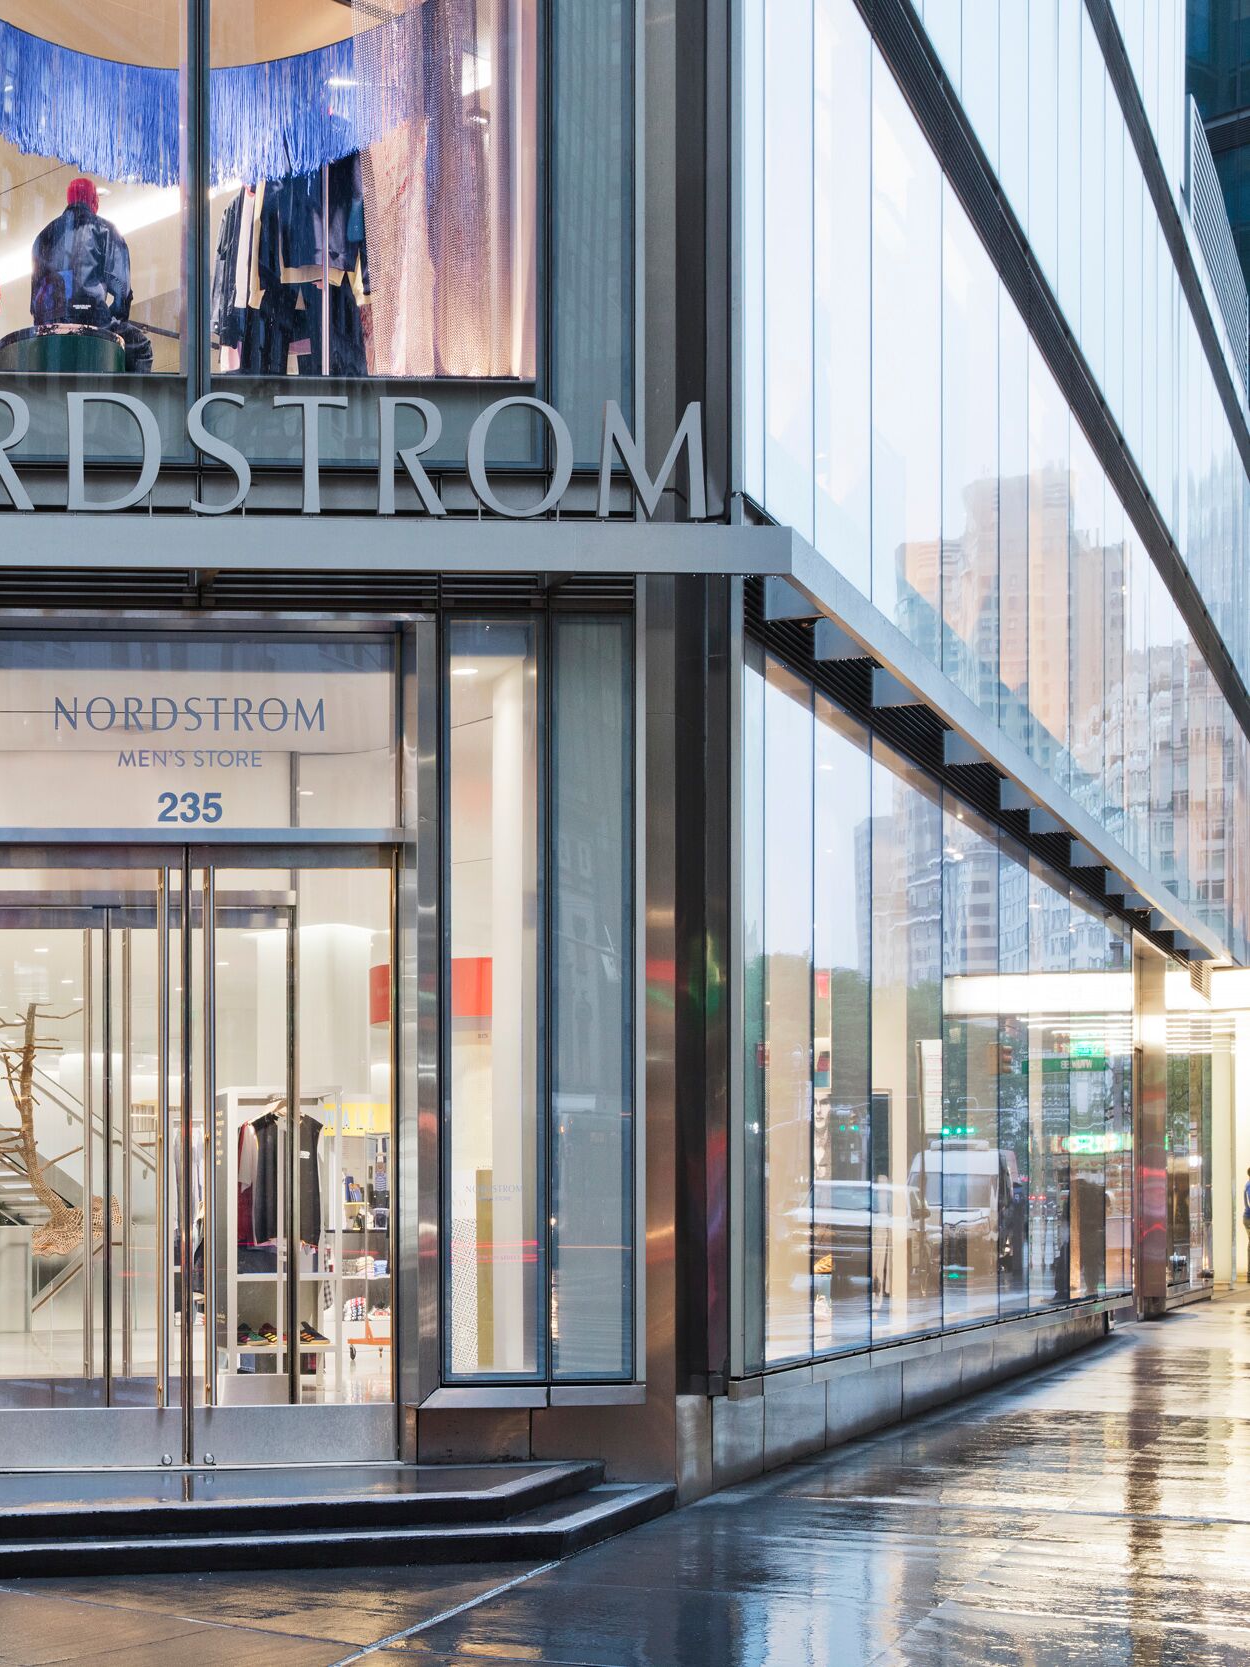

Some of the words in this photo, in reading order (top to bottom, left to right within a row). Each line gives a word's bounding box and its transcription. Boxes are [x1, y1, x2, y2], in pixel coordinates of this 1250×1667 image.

[54, 697, 326, 732] NORDSTROM
[194, 749, 263, 768] STORE
[157, 791, 223, 823] 235
